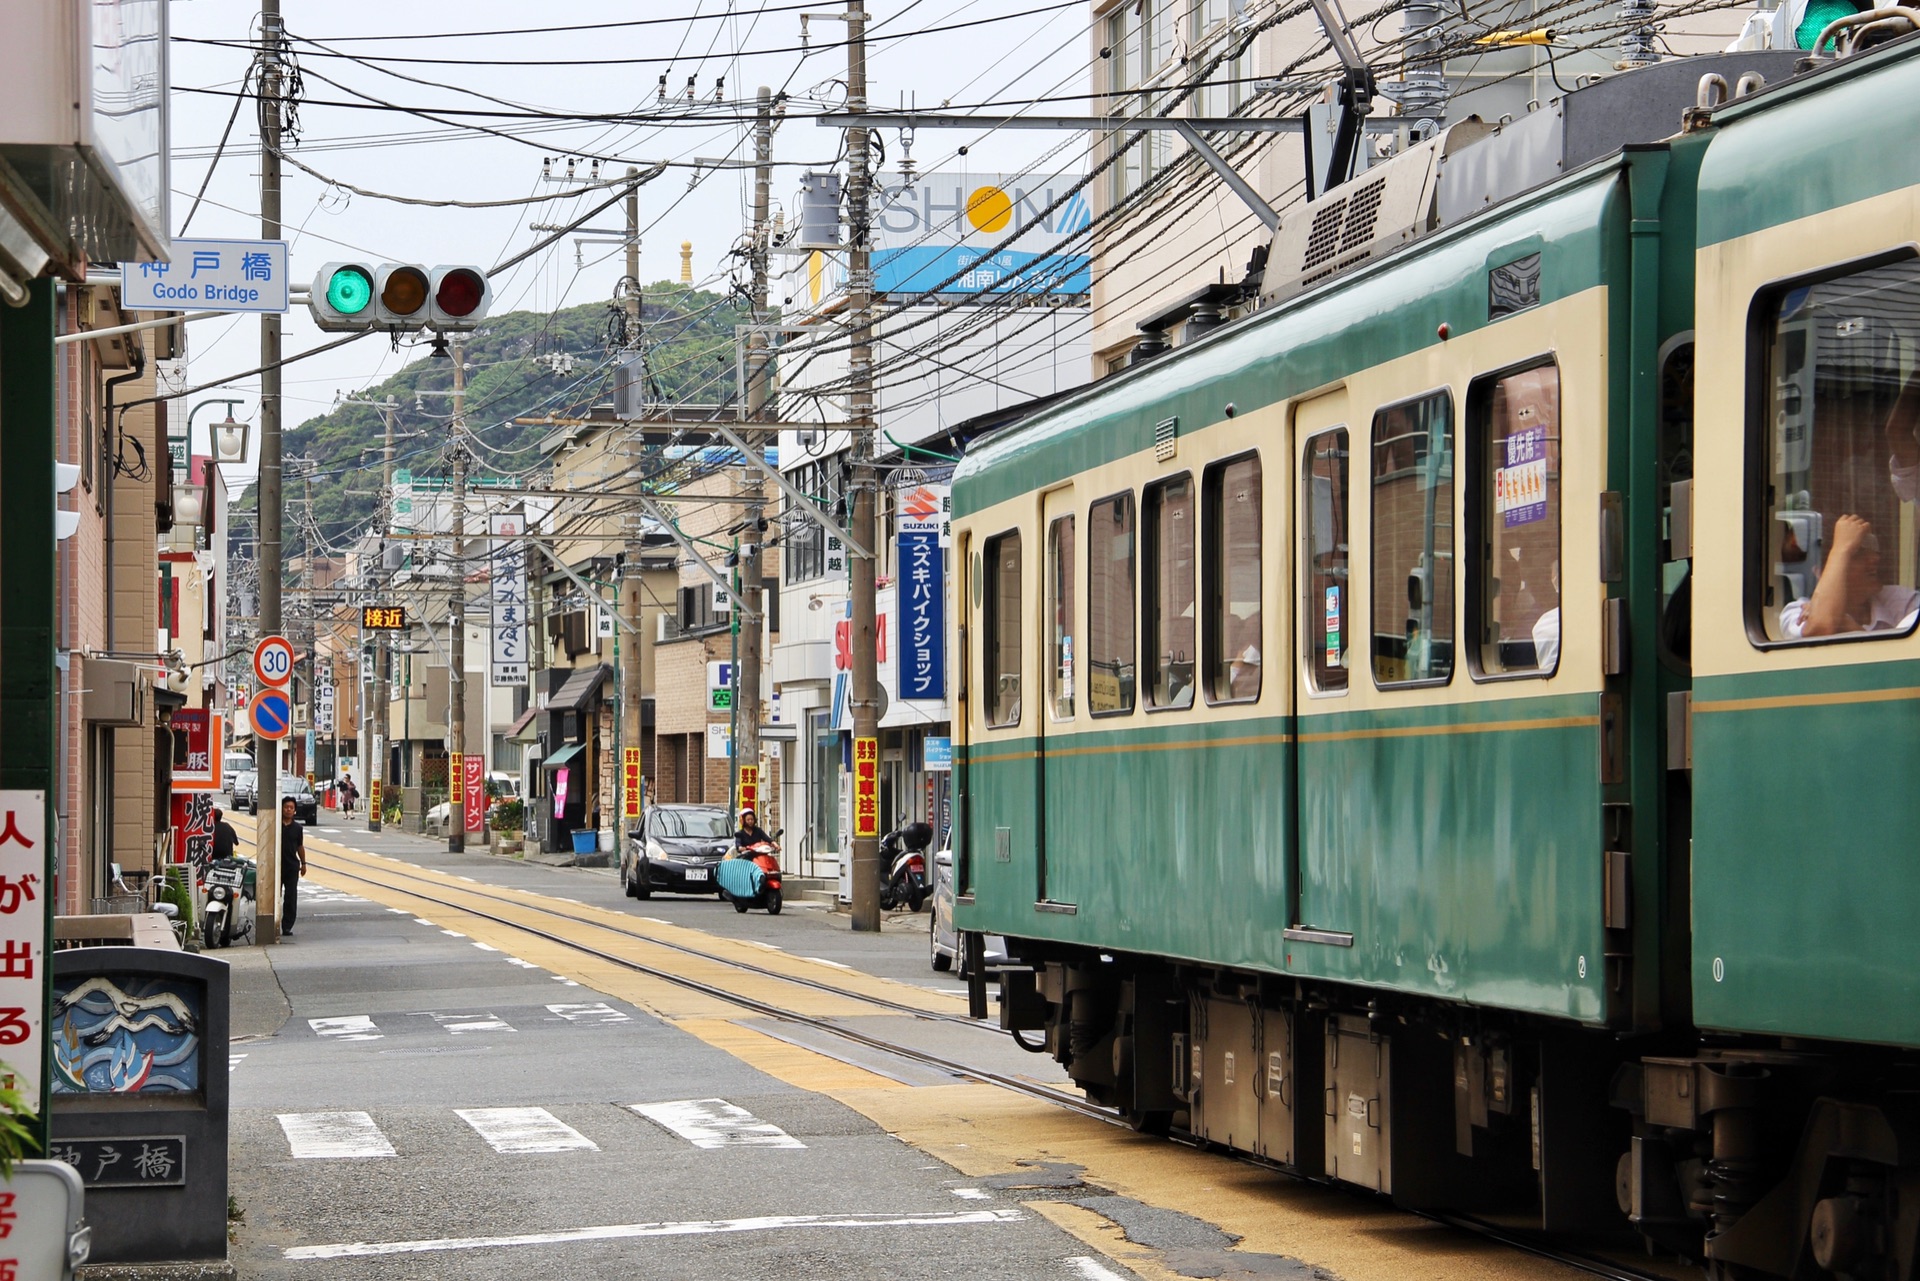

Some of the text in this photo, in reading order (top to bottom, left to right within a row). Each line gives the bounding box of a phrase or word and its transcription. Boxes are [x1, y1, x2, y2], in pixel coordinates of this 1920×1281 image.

[152, 282, 259, 304] Godo Bridge
[1507, 430, 1534, 466] 優先席
[827, 536, 842, 571] 腰越
[365, 608, 402, 627] 接近
[912, 536, 931, 692] スズキバイクショップ
[264, 650, 288, 673] 30
[466, 763, 480, 830] サンマーメン
[626, 765, 638, 815] 電車注意
[858, 762, 875, 832] 電車注意
